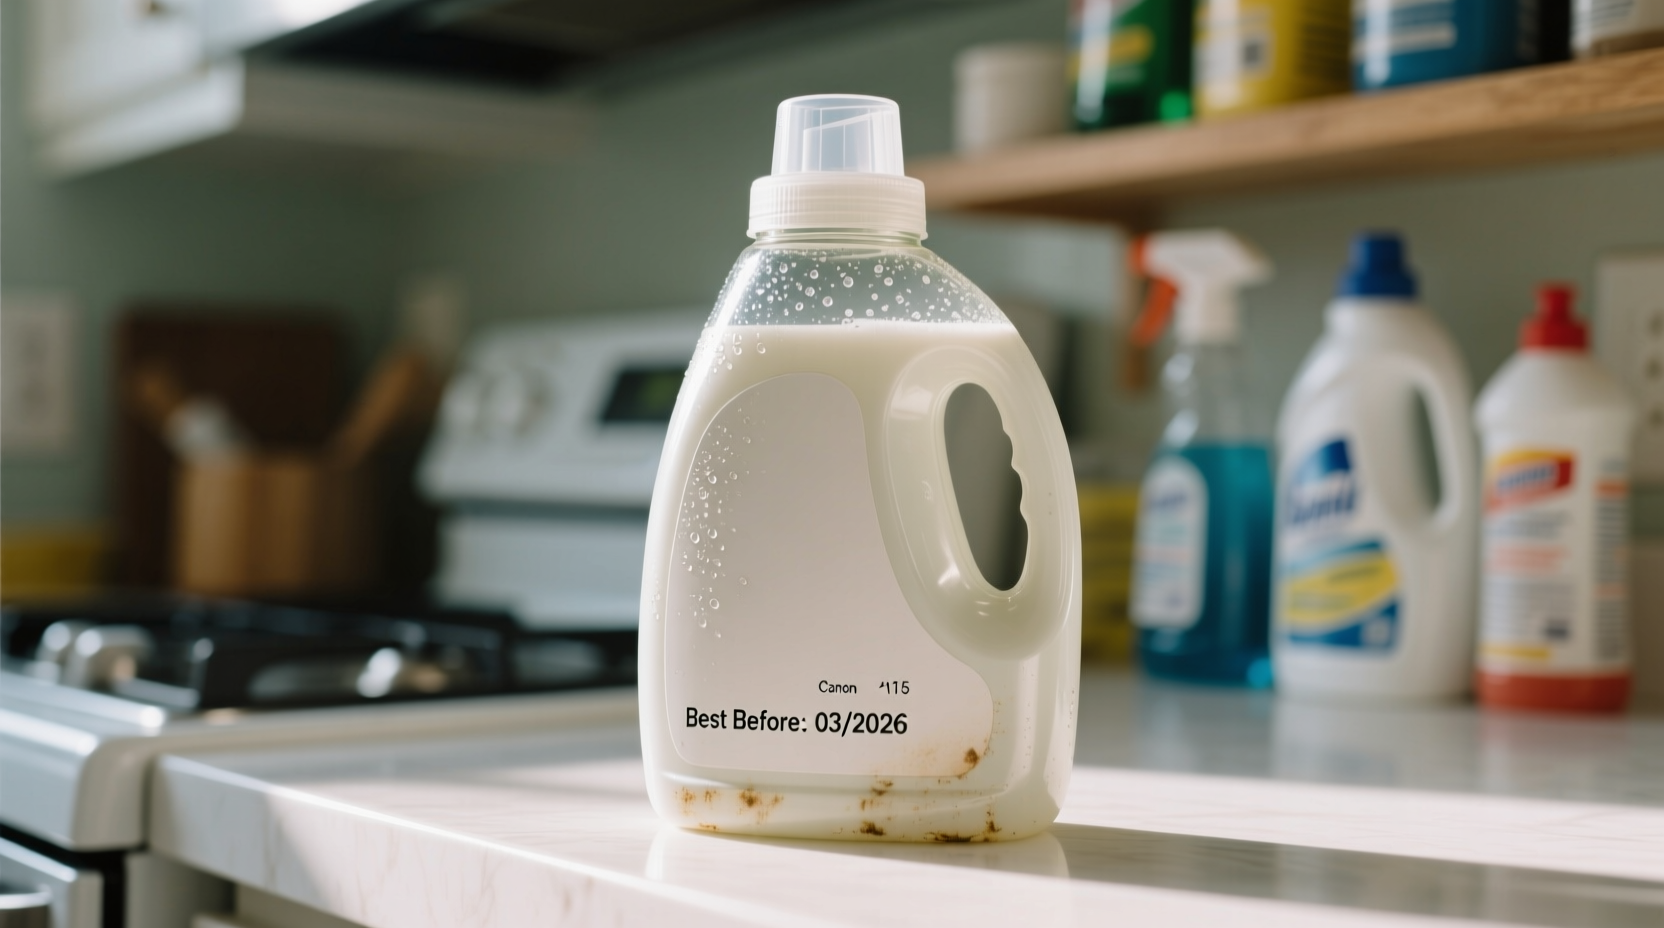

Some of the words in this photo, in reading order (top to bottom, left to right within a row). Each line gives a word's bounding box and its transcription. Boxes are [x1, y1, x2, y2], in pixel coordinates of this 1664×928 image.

[818, 680, 857, 694] Canon
[686, 707, 728, 729] Best
[733, 709, 807, 732] Before:
[814, 712, 908, 738] 03/2026
